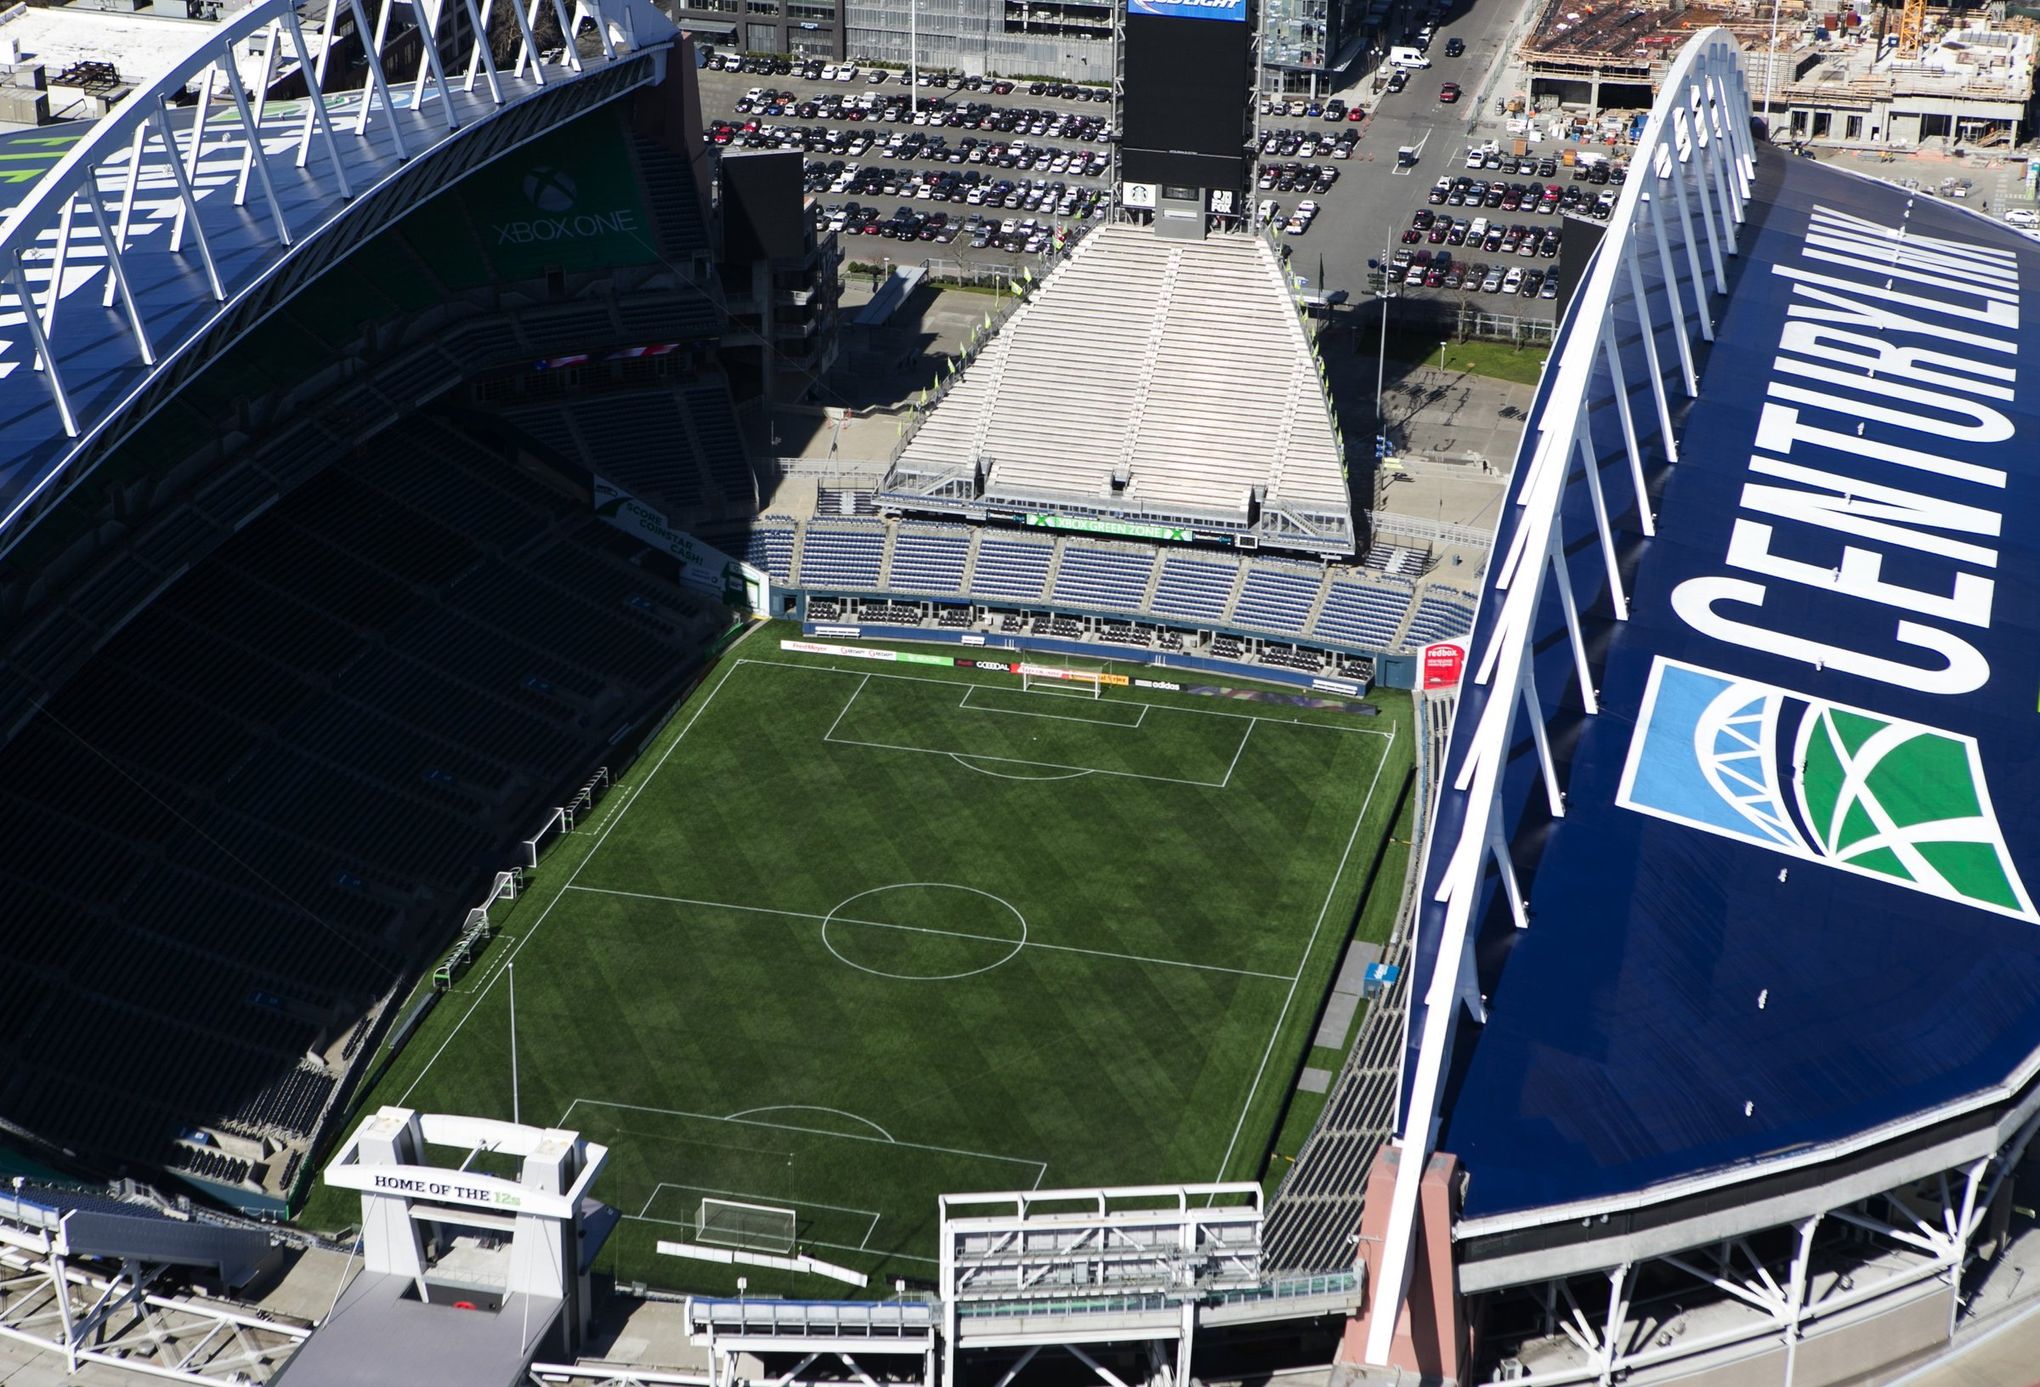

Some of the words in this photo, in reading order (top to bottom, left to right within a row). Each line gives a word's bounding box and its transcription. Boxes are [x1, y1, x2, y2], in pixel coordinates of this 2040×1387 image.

[491, 217, 575, 245] XBOX
[574, 209, 638, 236] ONE
[627, 503, 662, 526] SCORE
[639, 519, 694, 550] COINSTAR
[1058, 517, 1088, 530] XBOX
[1089, 520, 1127, 535] GREEN
[1129, 525, 1162, 538] ZONE
[670, 543, 704, 566] CASH!
[1152, 680, 1180, 691] adidas
[375, 1175, 426, 1193] HOME
[429, 1182, 450, 1195] OF
[454, 1186, 490, 1201] THE
